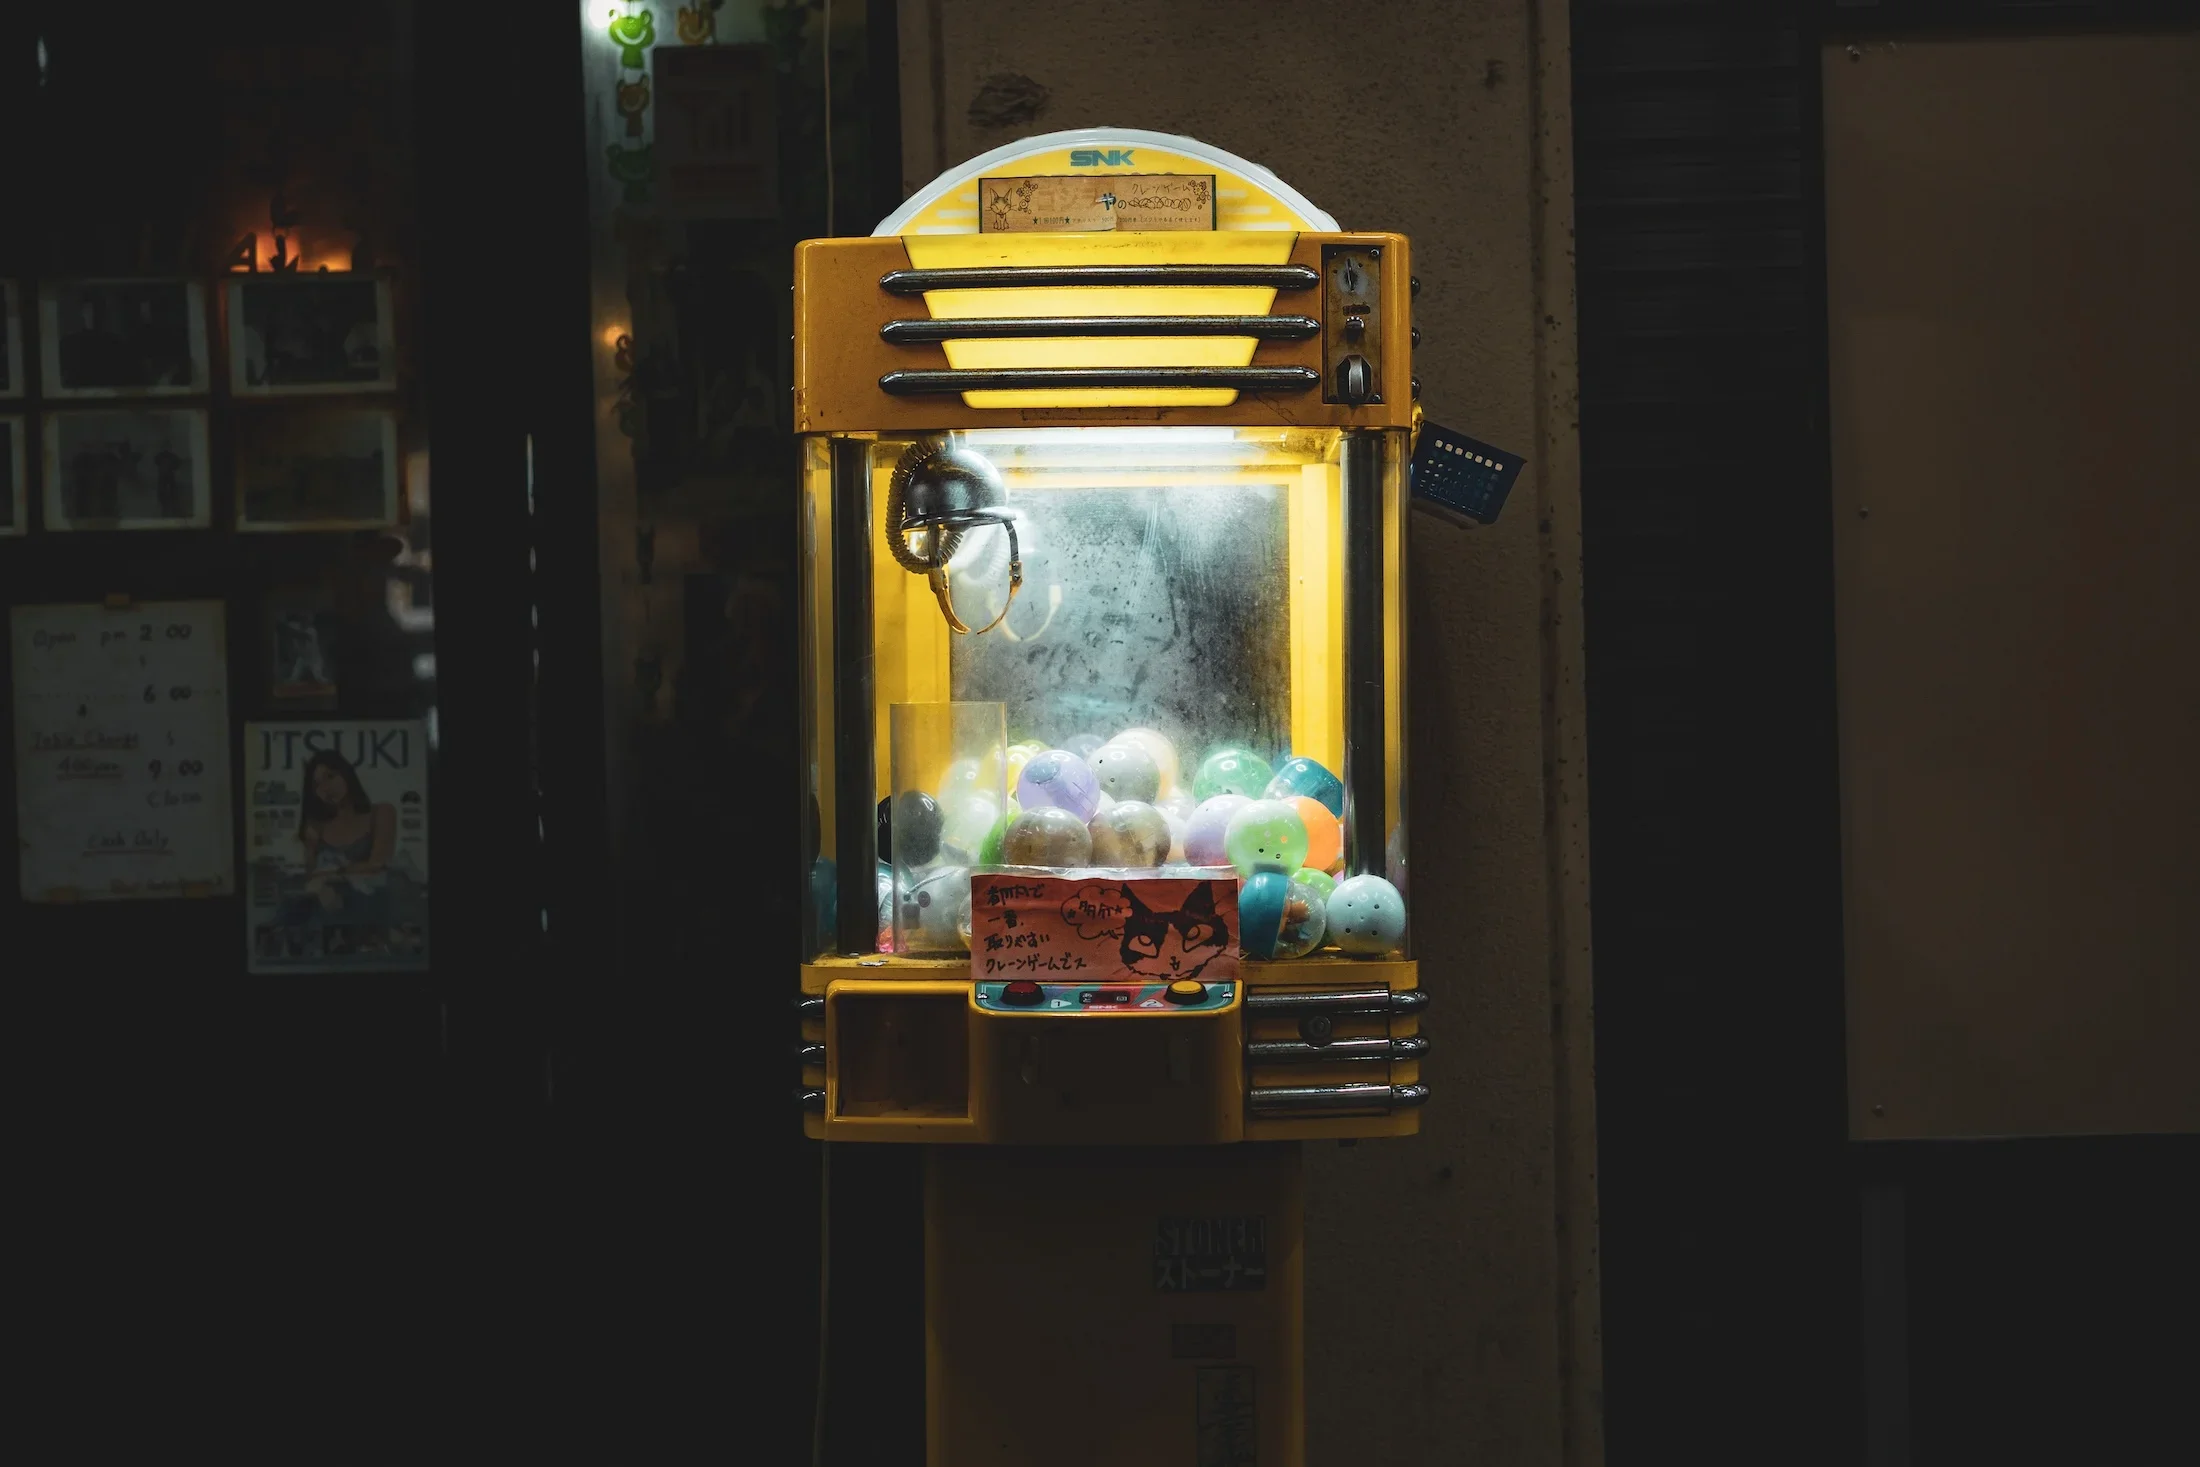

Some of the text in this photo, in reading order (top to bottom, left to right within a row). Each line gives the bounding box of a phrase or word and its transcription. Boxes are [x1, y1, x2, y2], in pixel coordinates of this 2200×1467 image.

[1070, 150, 1135, 166] SNK
[32, 628, 77, 651] Open
[139, 623, 154, 642] 2
[143, 683, 157, 705] 6
[260, 729, 410, 770] ITSUKI
[984, 931, 1050, 952] 取りやすい
[1155, 1255, 1265, 1291] ストーナー
